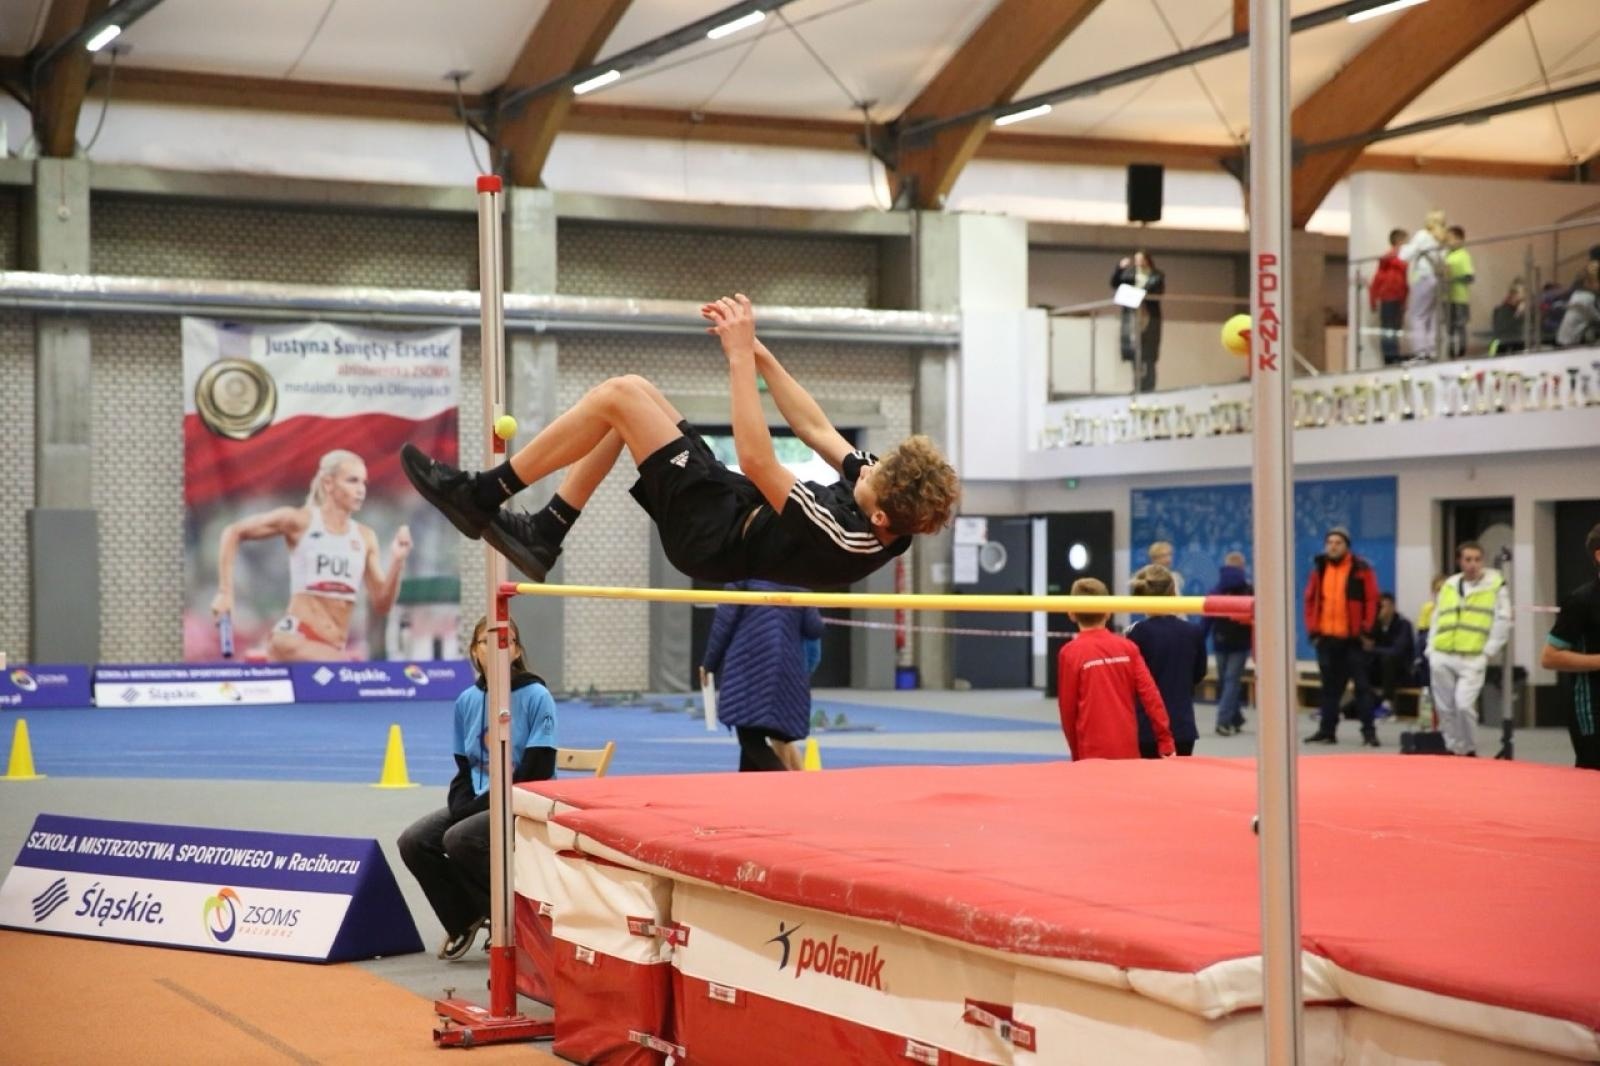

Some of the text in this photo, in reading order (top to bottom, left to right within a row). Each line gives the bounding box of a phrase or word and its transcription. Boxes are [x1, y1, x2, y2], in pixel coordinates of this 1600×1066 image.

[1258, 253, 1280, 371] POLANIK
[265, 335, 329, 359] Justyna
[77, 836, 174, 861] MISTRZOSTWA
[175, 844, 273, 869] SPORTOWEGO
[273, 855, 288, 870] w
[288, 852, 361, 875] Raciborzu
[75, 881, 165, 926] Śląskie.
[242, 905, 301, 927] ZSOMS
[795, 934, 885, 991] polanik
